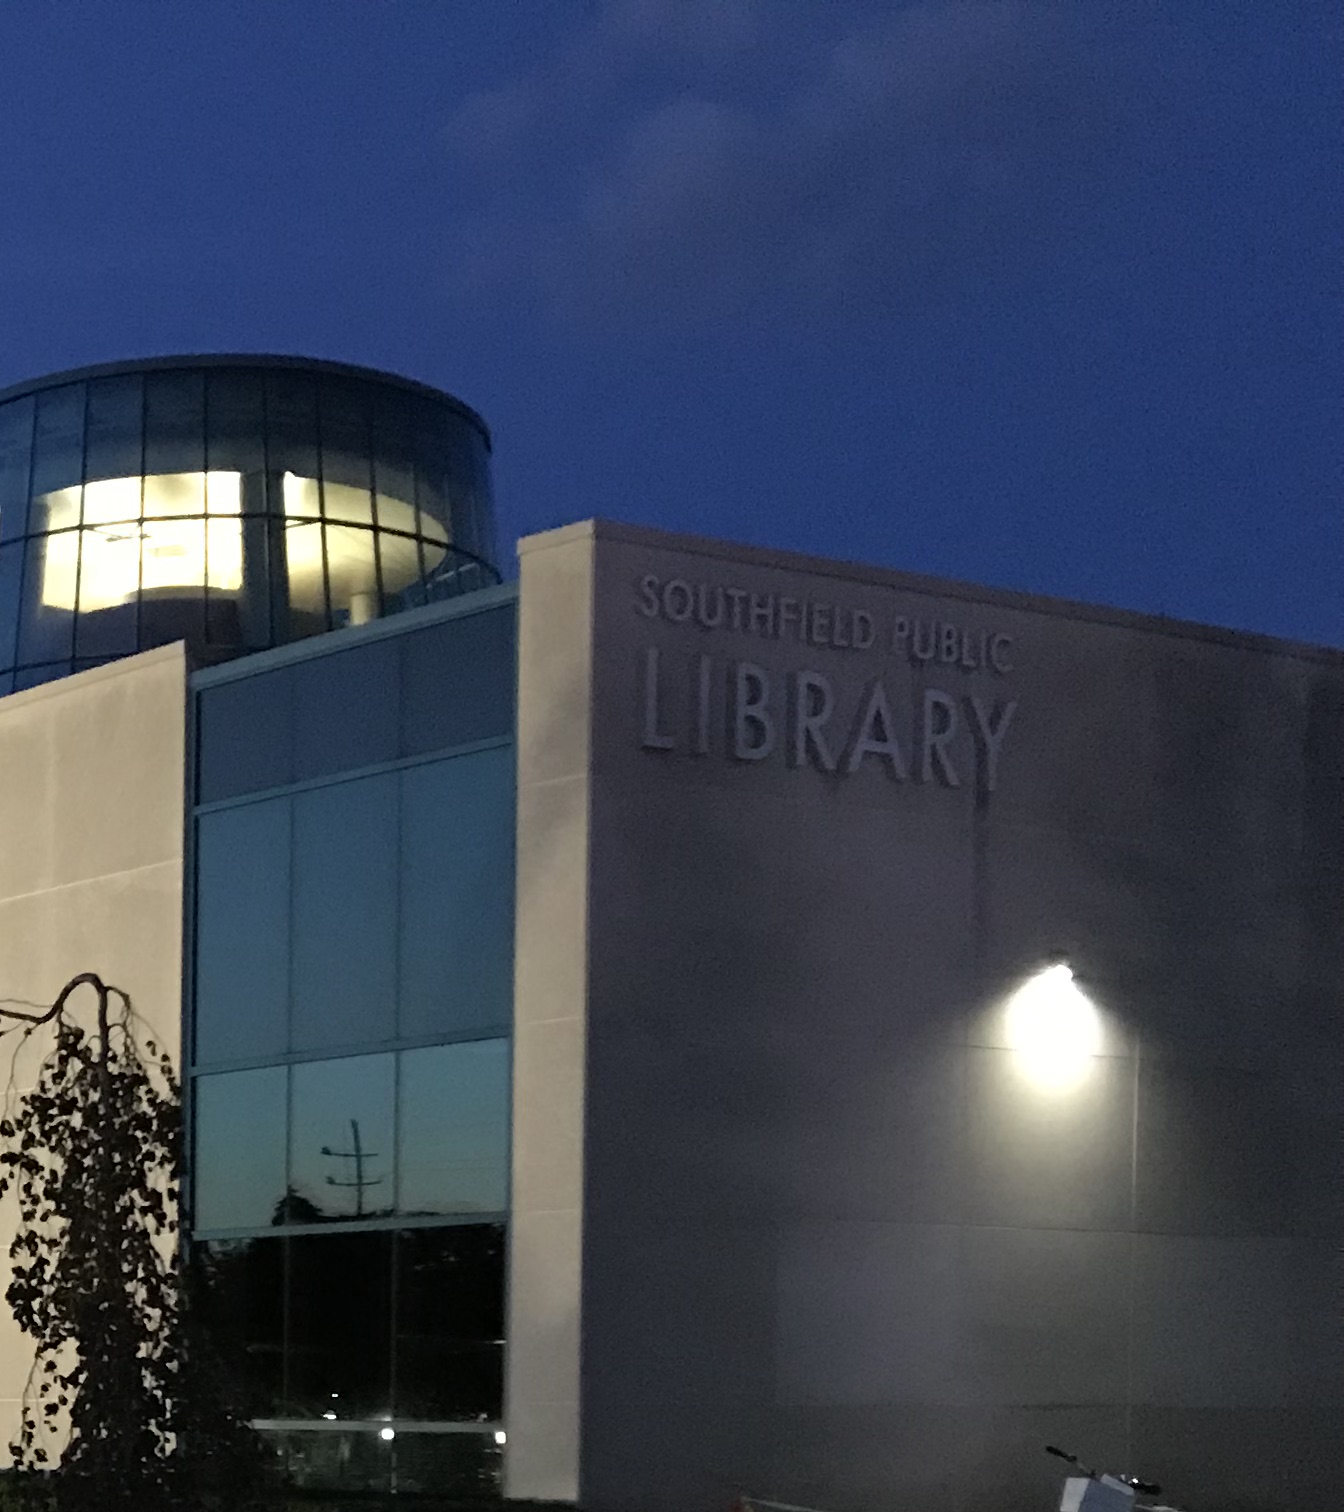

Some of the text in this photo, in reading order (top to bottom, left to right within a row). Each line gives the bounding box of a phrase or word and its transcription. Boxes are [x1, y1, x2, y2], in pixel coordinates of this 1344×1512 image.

[639, 574, 1014, 672] SOUTHFIELD PUBLIC
[642, 646, 1018, 791] LIBRARY
